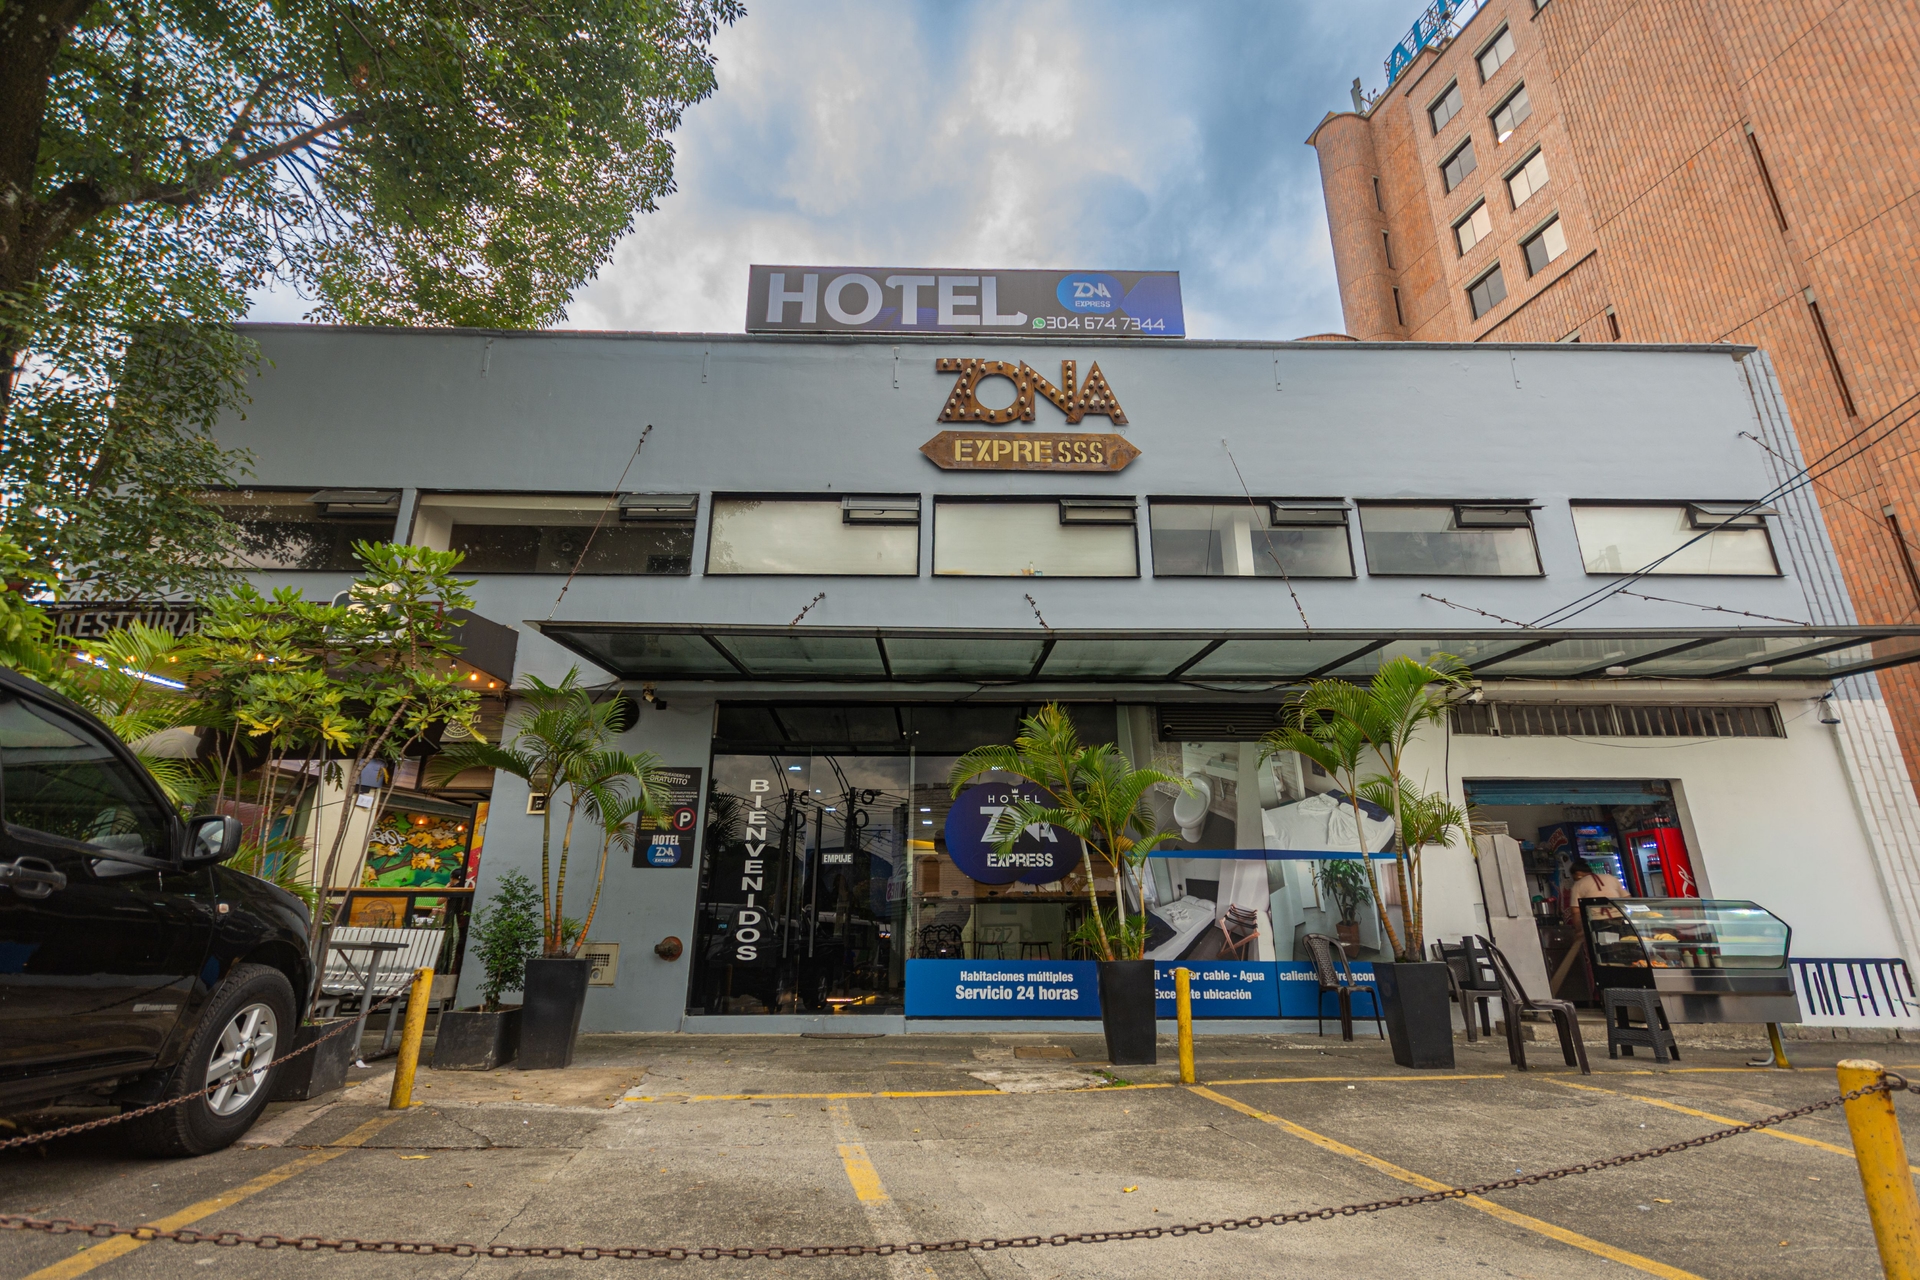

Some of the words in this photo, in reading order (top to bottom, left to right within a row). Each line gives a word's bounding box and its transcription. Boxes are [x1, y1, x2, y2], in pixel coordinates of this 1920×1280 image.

[765, 273, 1028, 326] HOTEL
[1075, 300, 1111, 308] EXPRESS
[1047, 316, 1080, 329] 304
[1085, 317, 1117, 330] 674
[1121, 317, 1165, 331] 7344
[936, 358, 1129, 425] ZONA
[954, 439, 1103, 464] EXPRESSS
[988, 795, 1041, 803] HOTEL
[652, 835, 680, 845] HOTEL
[987, 853, 1053, 867] EXPRESS
[736, 779, 770, 961] BIENVENIDOS
[960, 971, 1025, 982] Habitaciones
[1027, 971, 1074, 983] múltiples
[1203, 970, 1230, 980] cable
[1240, 970, 1265, 983] Agua
[1280, 971, 1319, 981] caliente
[1352, 972, 1376, 982] acon
[955, 985, 1013, 1000] Servicio
[1016, 986, 1035, 1000] 24
[1039, 986, 1079, 1001] horas
[1203, 989, 1252, 1000] ubicación
